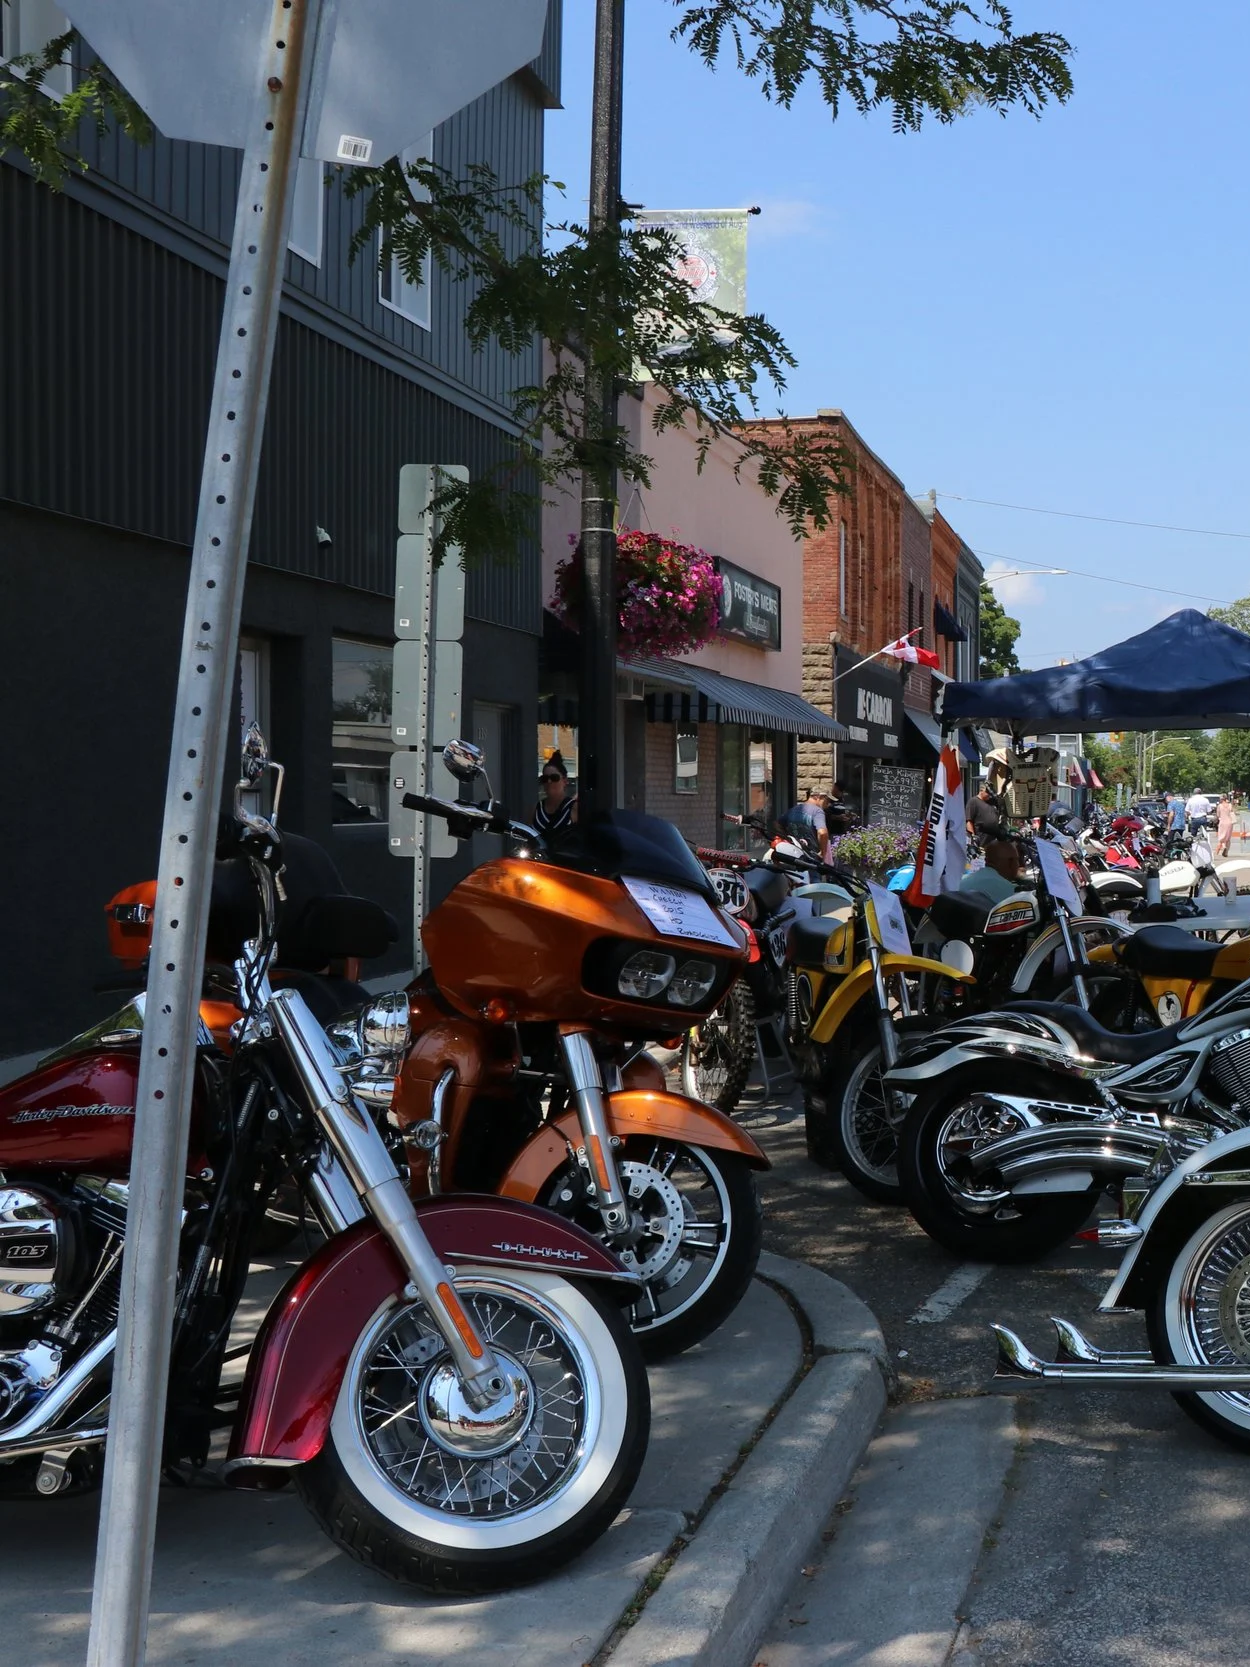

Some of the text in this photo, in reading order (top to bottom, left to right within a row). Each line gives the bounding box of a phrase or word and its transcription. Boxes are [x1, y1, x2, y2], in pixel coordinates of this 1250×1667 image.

[760, 593, 777, 615] MEATS
[885, 791, 910, 801] Chops
[900, 785, 916, 794] Pork
[13, 1103, 133, 1123] Harley-Davidson
[7, 1245, 48, 1258] 103
[500, 1242, 581, 1260] DELUXE
